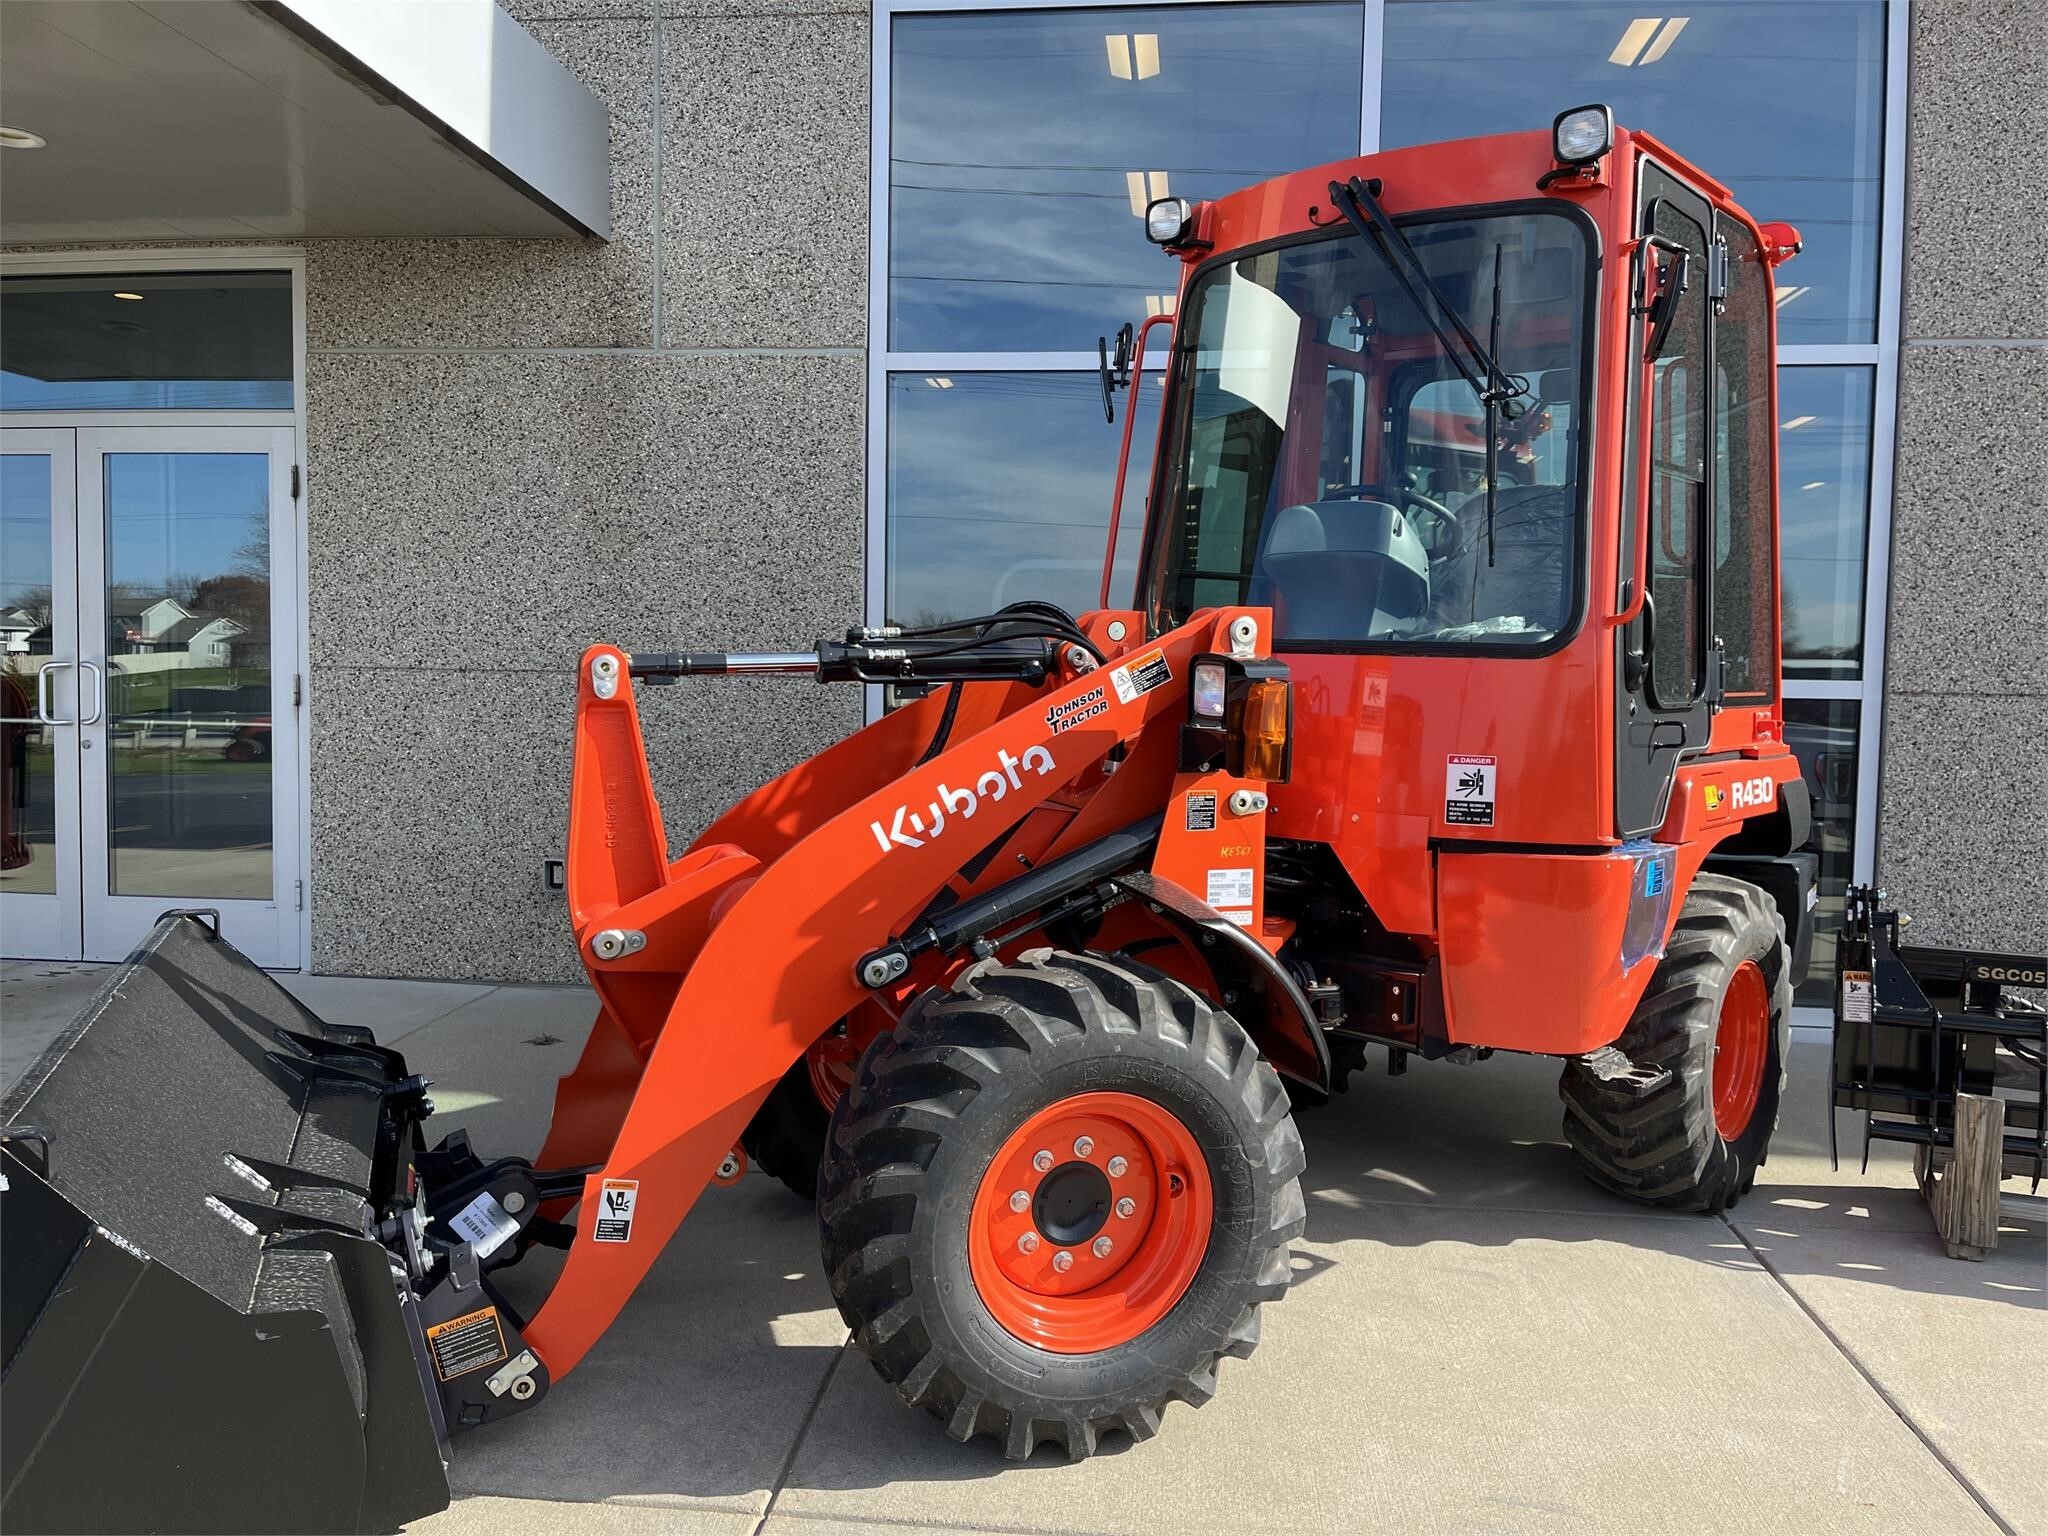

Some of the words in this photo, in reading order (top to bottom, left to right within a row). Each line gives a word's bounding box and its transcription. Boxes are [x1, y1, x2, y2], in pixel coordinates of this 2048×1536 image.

[1046, 686, 1104, 723] JOHNSON
[1049, 701, 1108, 735] TRACTOR
[1460, 757, 1491, 765] DANGER
[870, 745, 1056, 853] Kubota
[1731, 776, 1773, 809] R430
[1977, 966, 2046, 984] SGC05
[447, 1311, 486, 1330] WARNING
